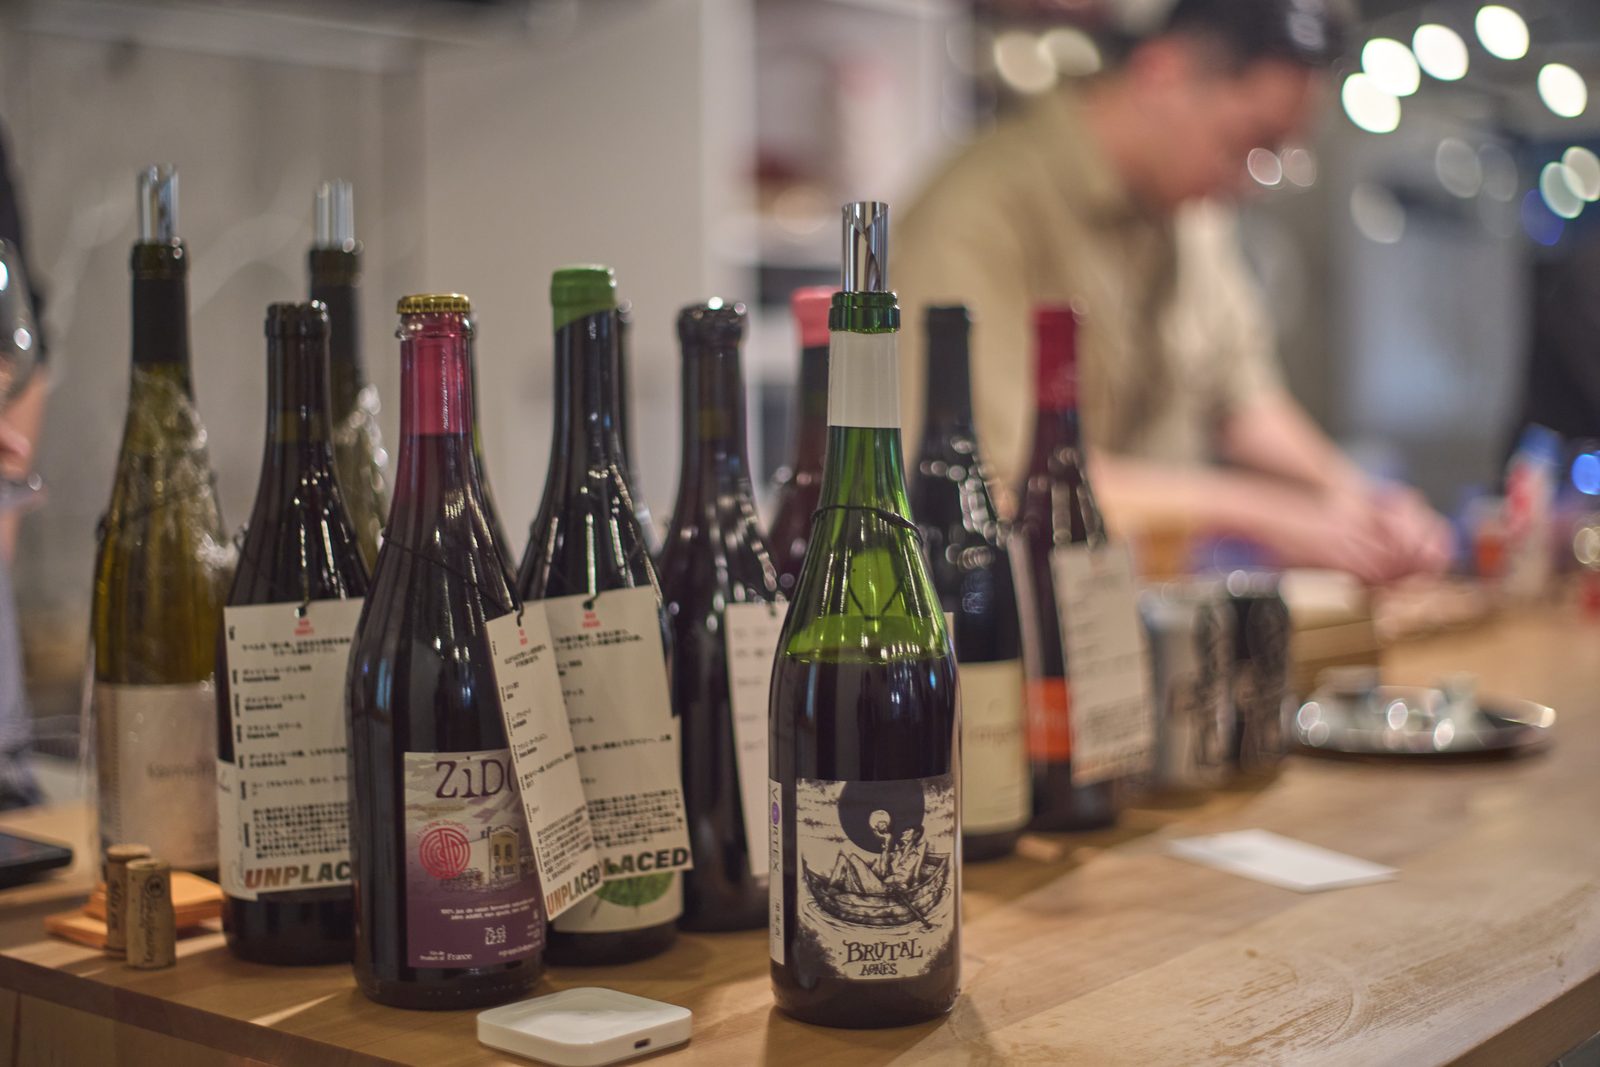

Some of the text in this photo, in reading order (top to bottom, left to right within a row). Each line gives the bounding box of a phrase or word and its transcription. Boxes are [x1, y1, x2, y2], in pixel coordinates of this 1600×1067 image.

[435, 755, 514, 799] ZiD
[546, 865, 601, 916] UNPLACED
[447, 953, 472, 961] France
[842, 938, 924, 966] BRUTAL
